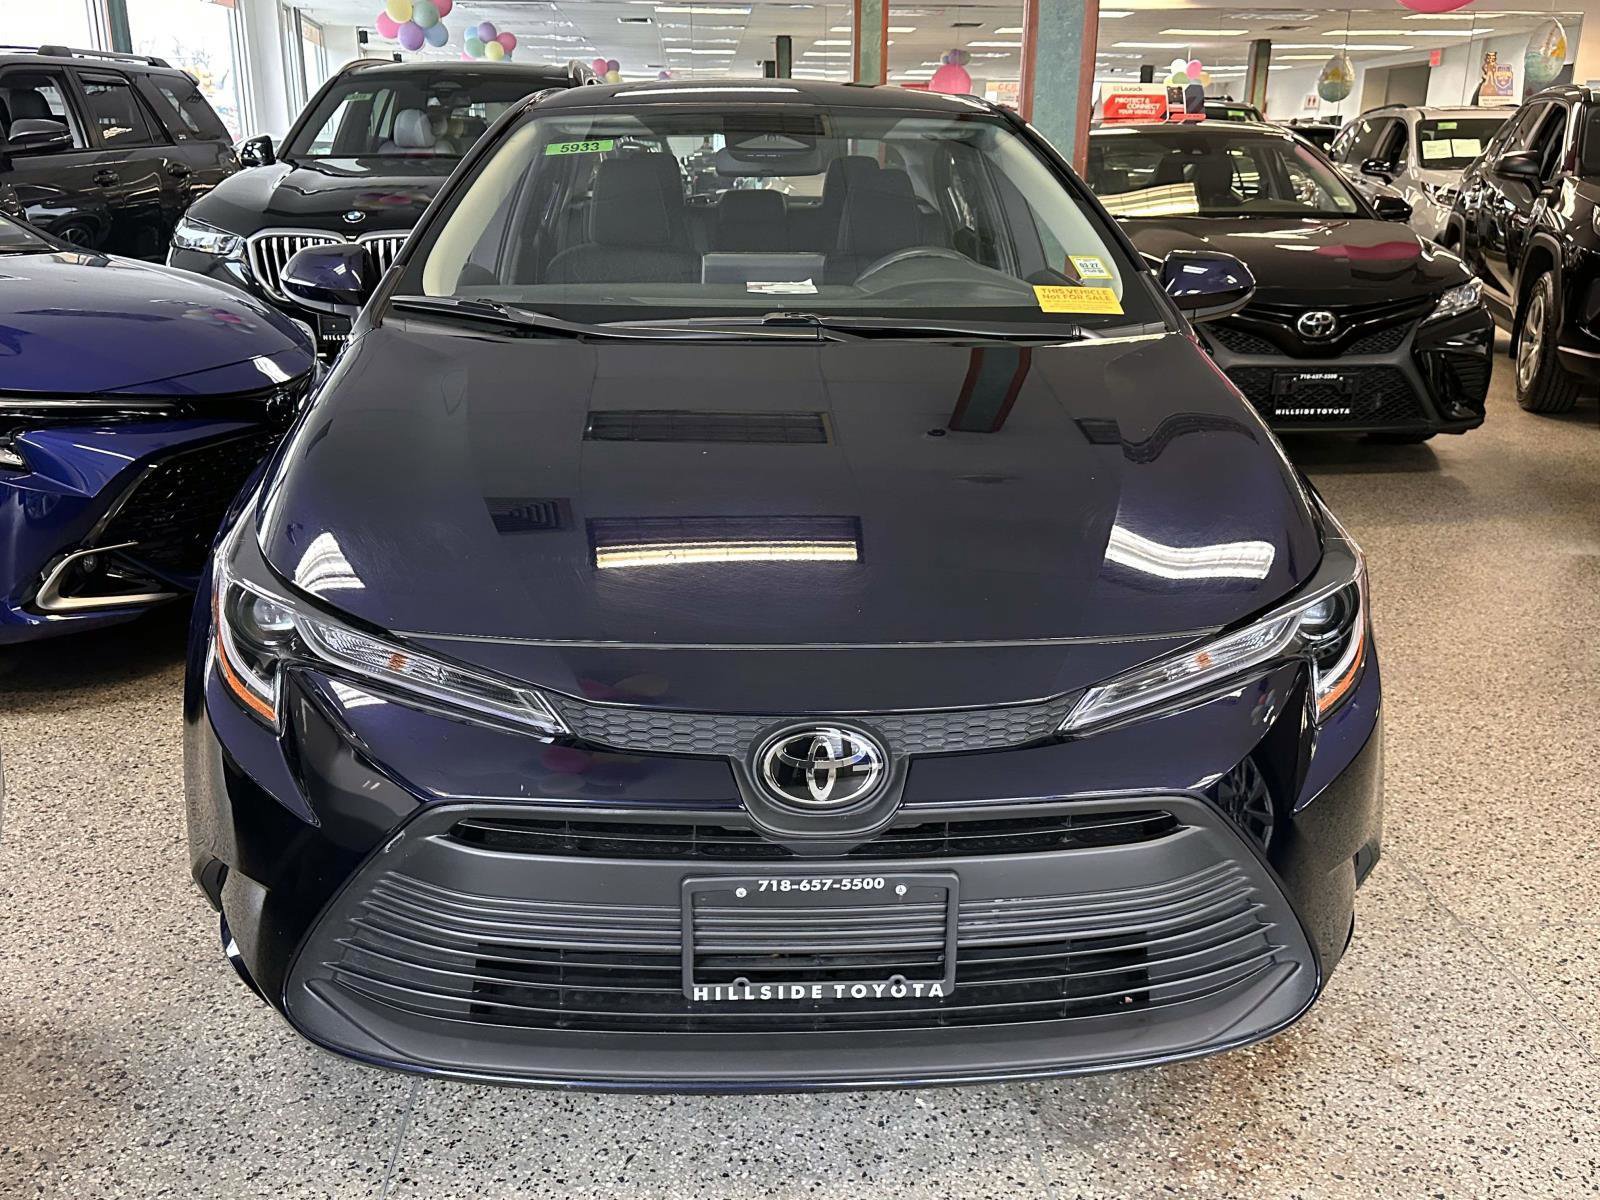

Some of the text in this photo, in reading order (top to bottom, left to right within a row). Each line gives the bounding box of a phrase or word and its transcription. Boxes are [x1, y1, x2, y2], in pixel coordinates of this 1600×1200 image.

[560, 142, 600, 153] 5933
[758, 877, 885, 892] 718-657-5500
[693, 983, 944, 1002] HILLSIDE TOYOTA
